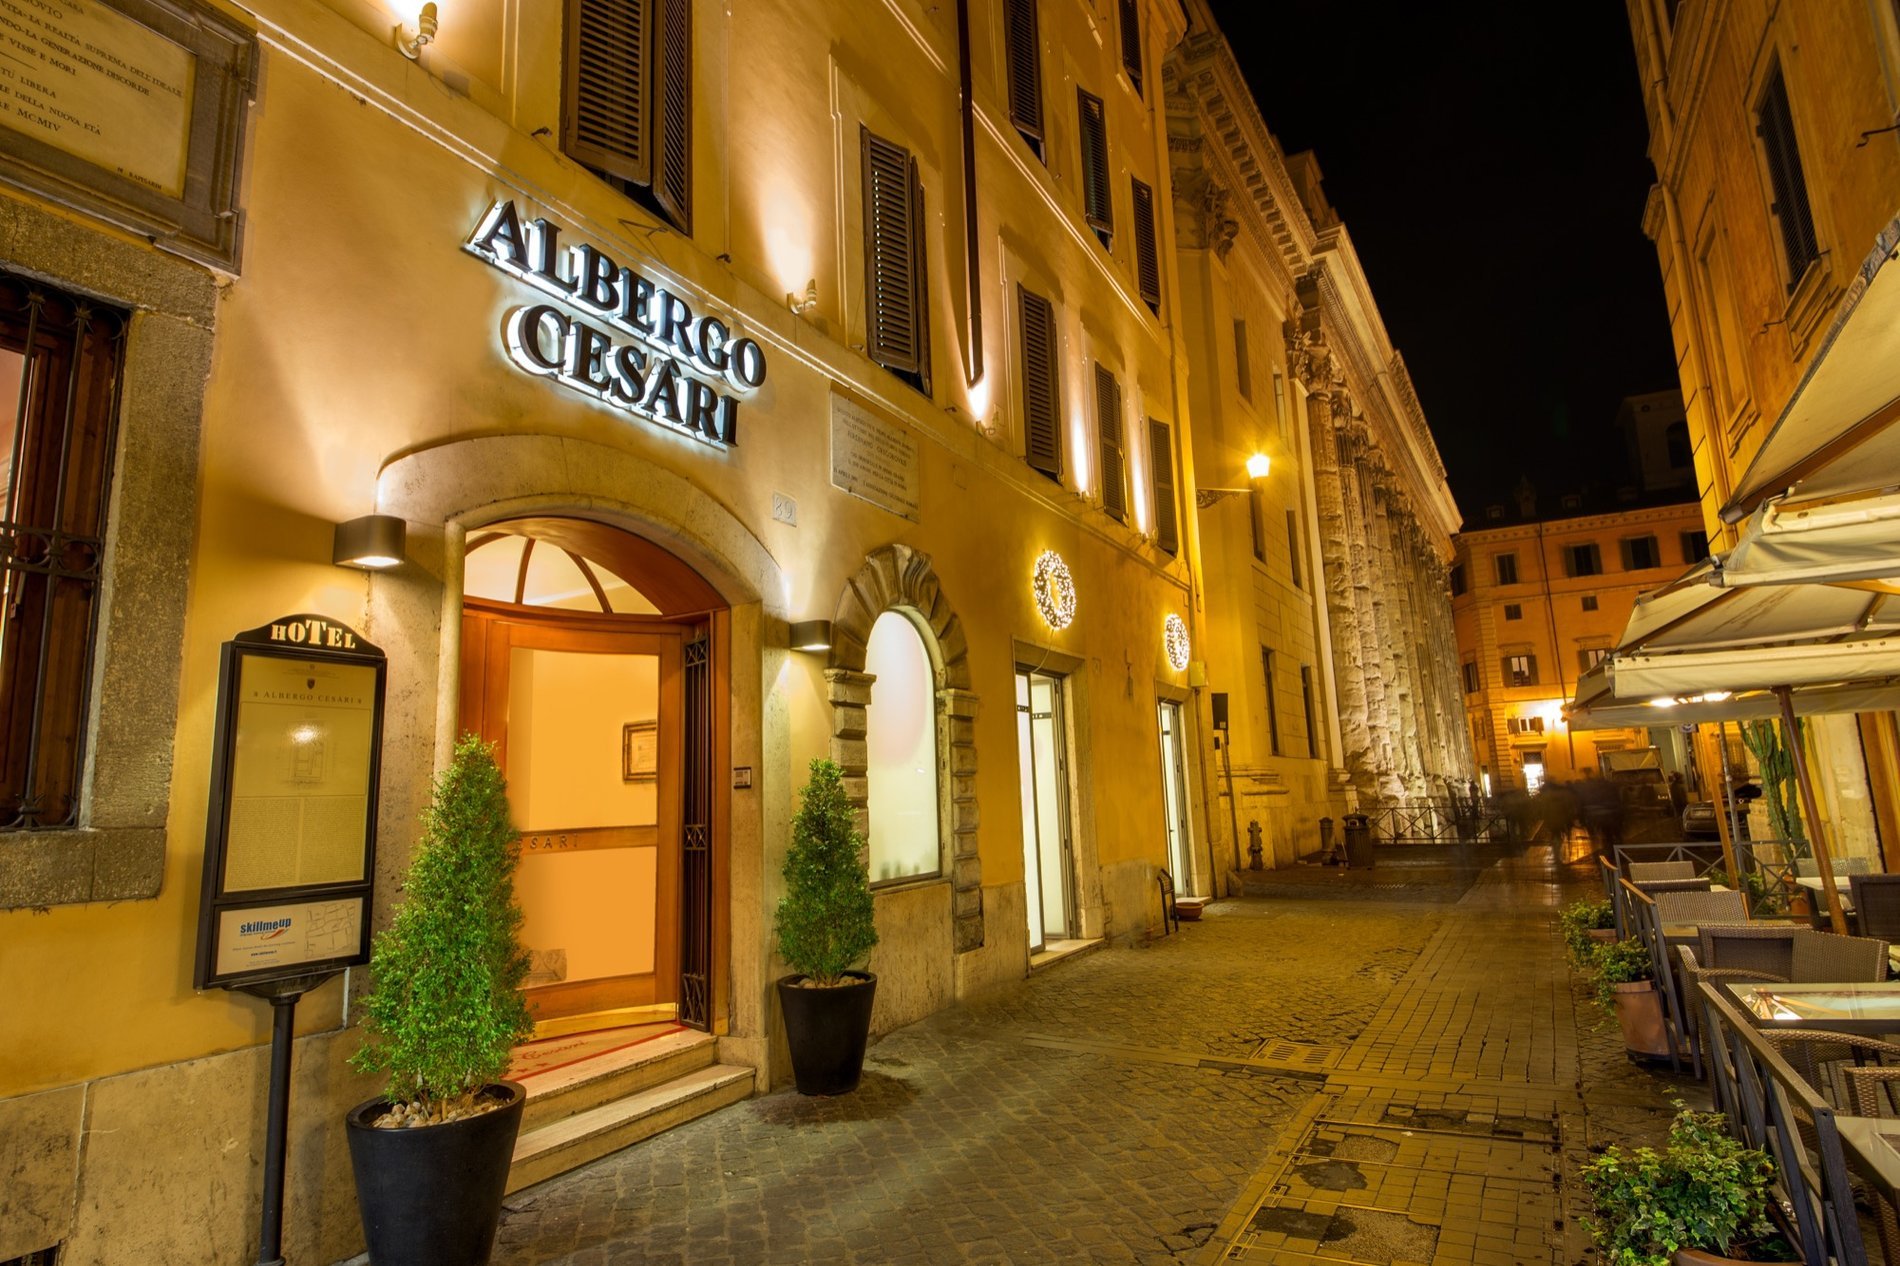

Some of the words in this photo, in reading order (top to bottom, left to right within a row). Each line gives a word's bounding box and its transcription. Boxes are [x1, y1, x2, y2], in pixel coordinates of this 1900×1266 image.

[9, 37, 37, 57] VISSE
[40, 52, 46, 61] E
[49, 57, 77, 76] MORI
[40, 37, 104, 74] GENERAZIONE
[106, 69, 150, 97] DISCORDE
[85, 42, 127, 70] SUPREMA
[20, 76, 57, 99] LIBERA
[15, 90, 45, 111] DELLA
[49, 106, 80, 127] NUOVA
[17, 107, 61, 132] MCMIV
[468, 199, 767, 390] ALBERGO
[270, 619, 357, 650] HOTEL
[263, 690, 313, 702] ALBERGO
[240, 917, 292, 934] skillmeup
